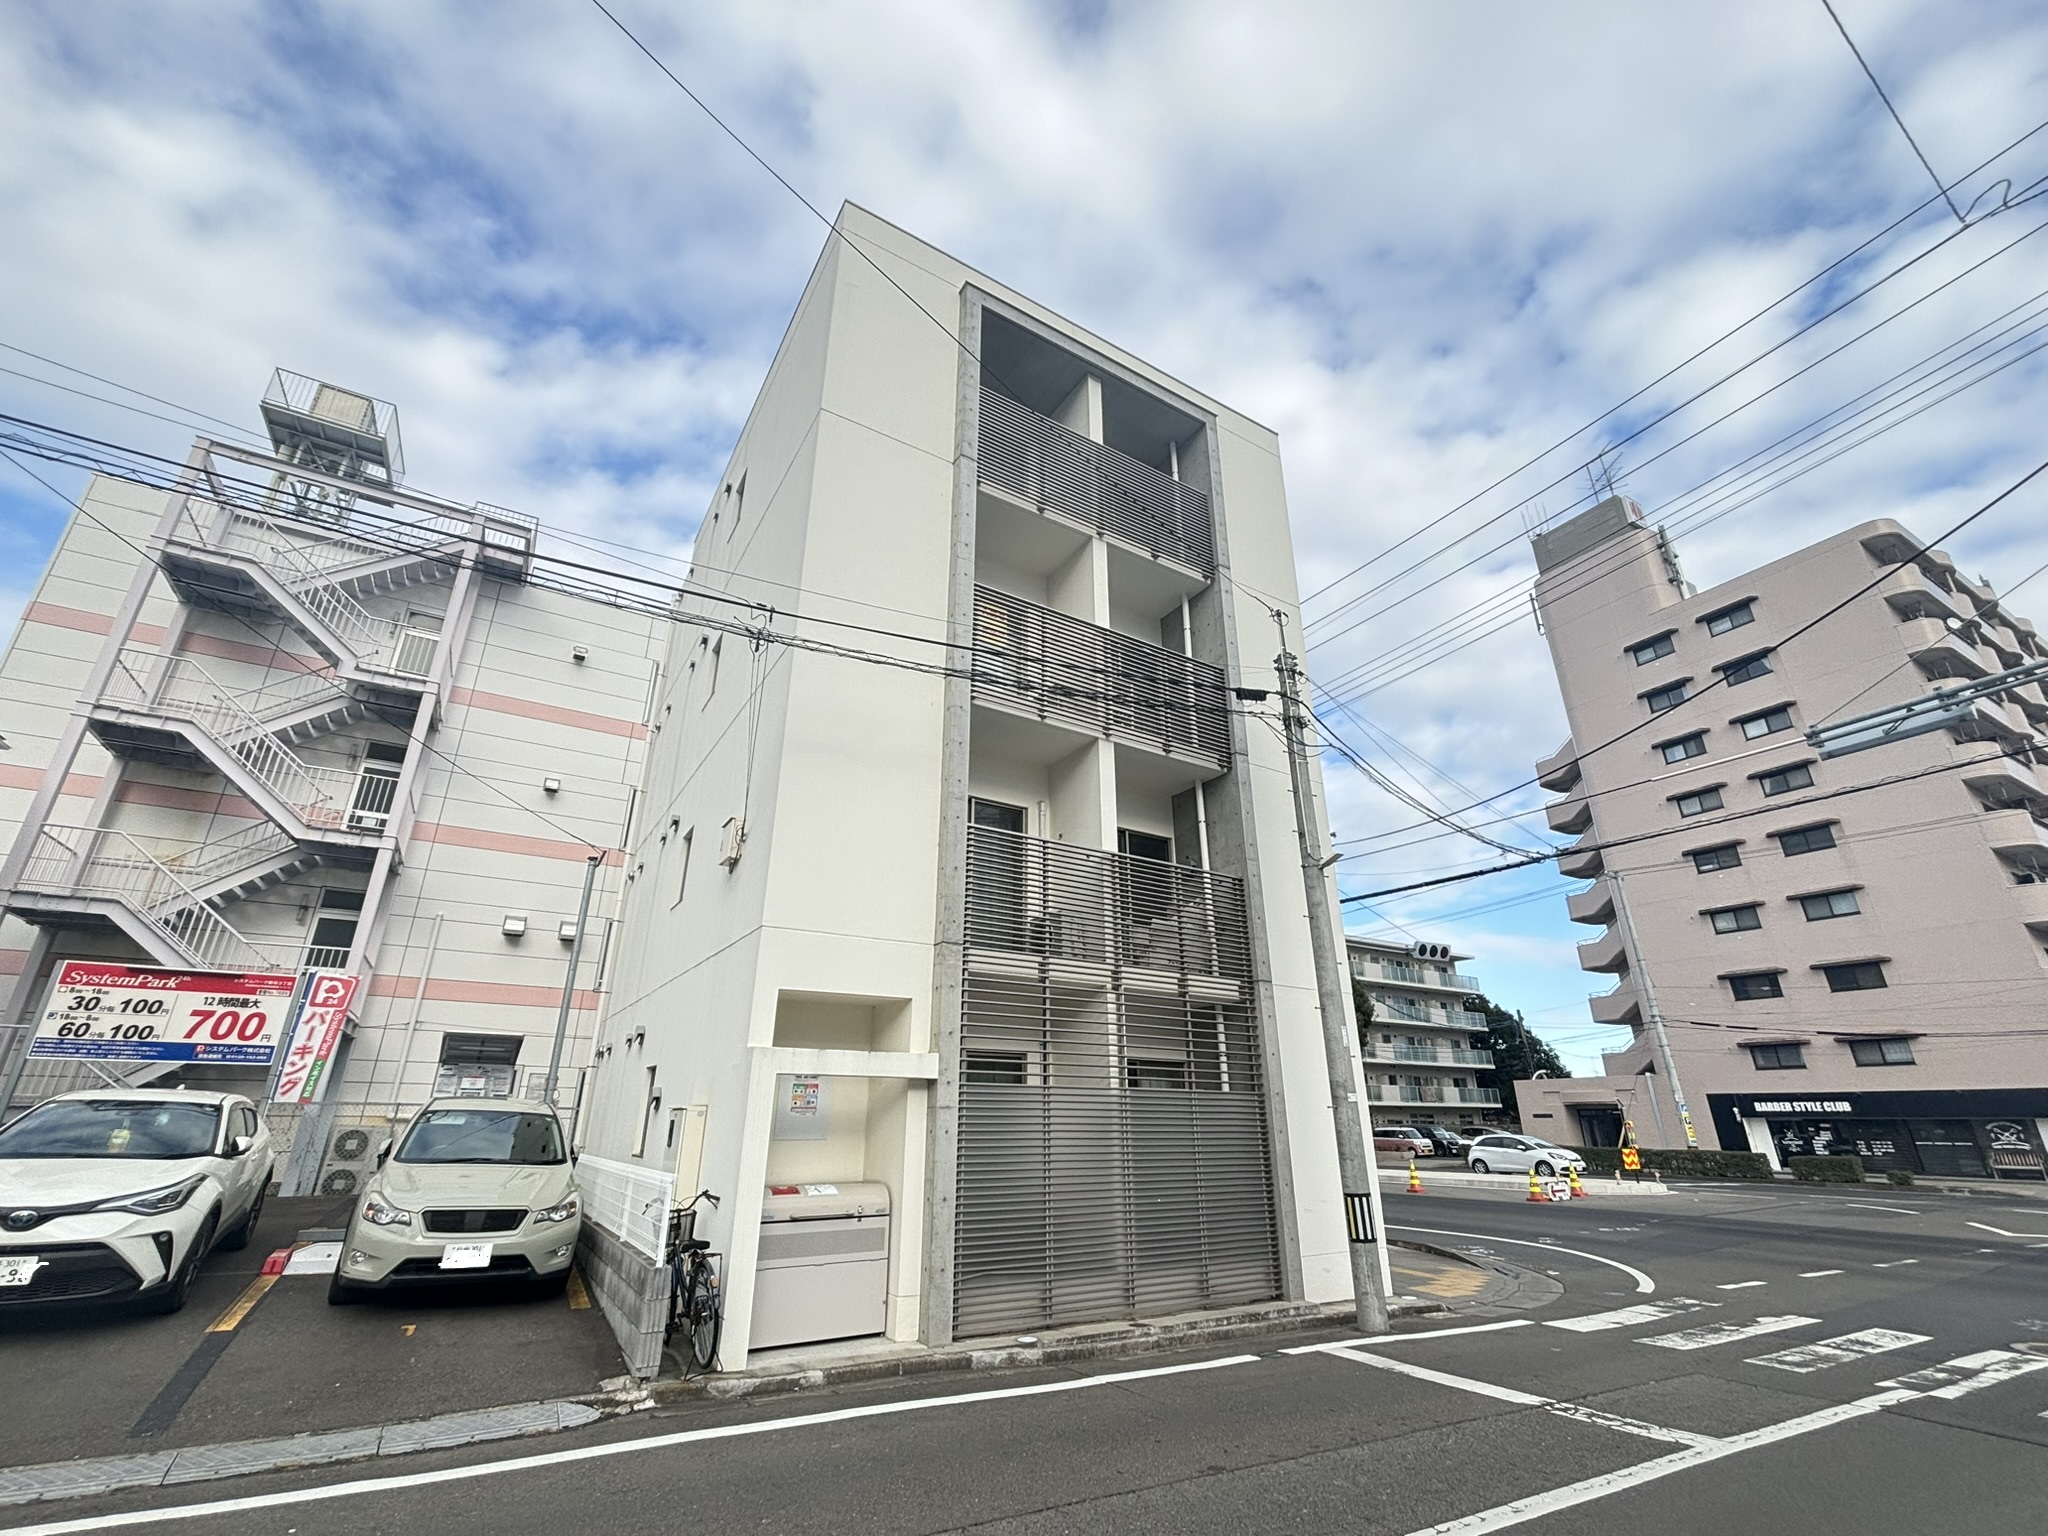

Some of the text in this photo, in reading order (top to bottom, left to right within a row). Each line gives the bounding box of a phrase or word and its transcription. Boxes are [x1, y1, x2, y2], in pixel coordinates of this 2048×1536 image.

[65, 970, 177, 988] SystemPark
[120, 998, 170, 1015] 100円
[110, 1024, 161, 1040] 100円
[182, 1009, 272, 1042] 700円
[317, 1011, 343, 1057] SystemPark
[279, 1010, 331, 1096] パーキング
[1753, 1101, 1852, 1112] BARBER STYLE CLUB
